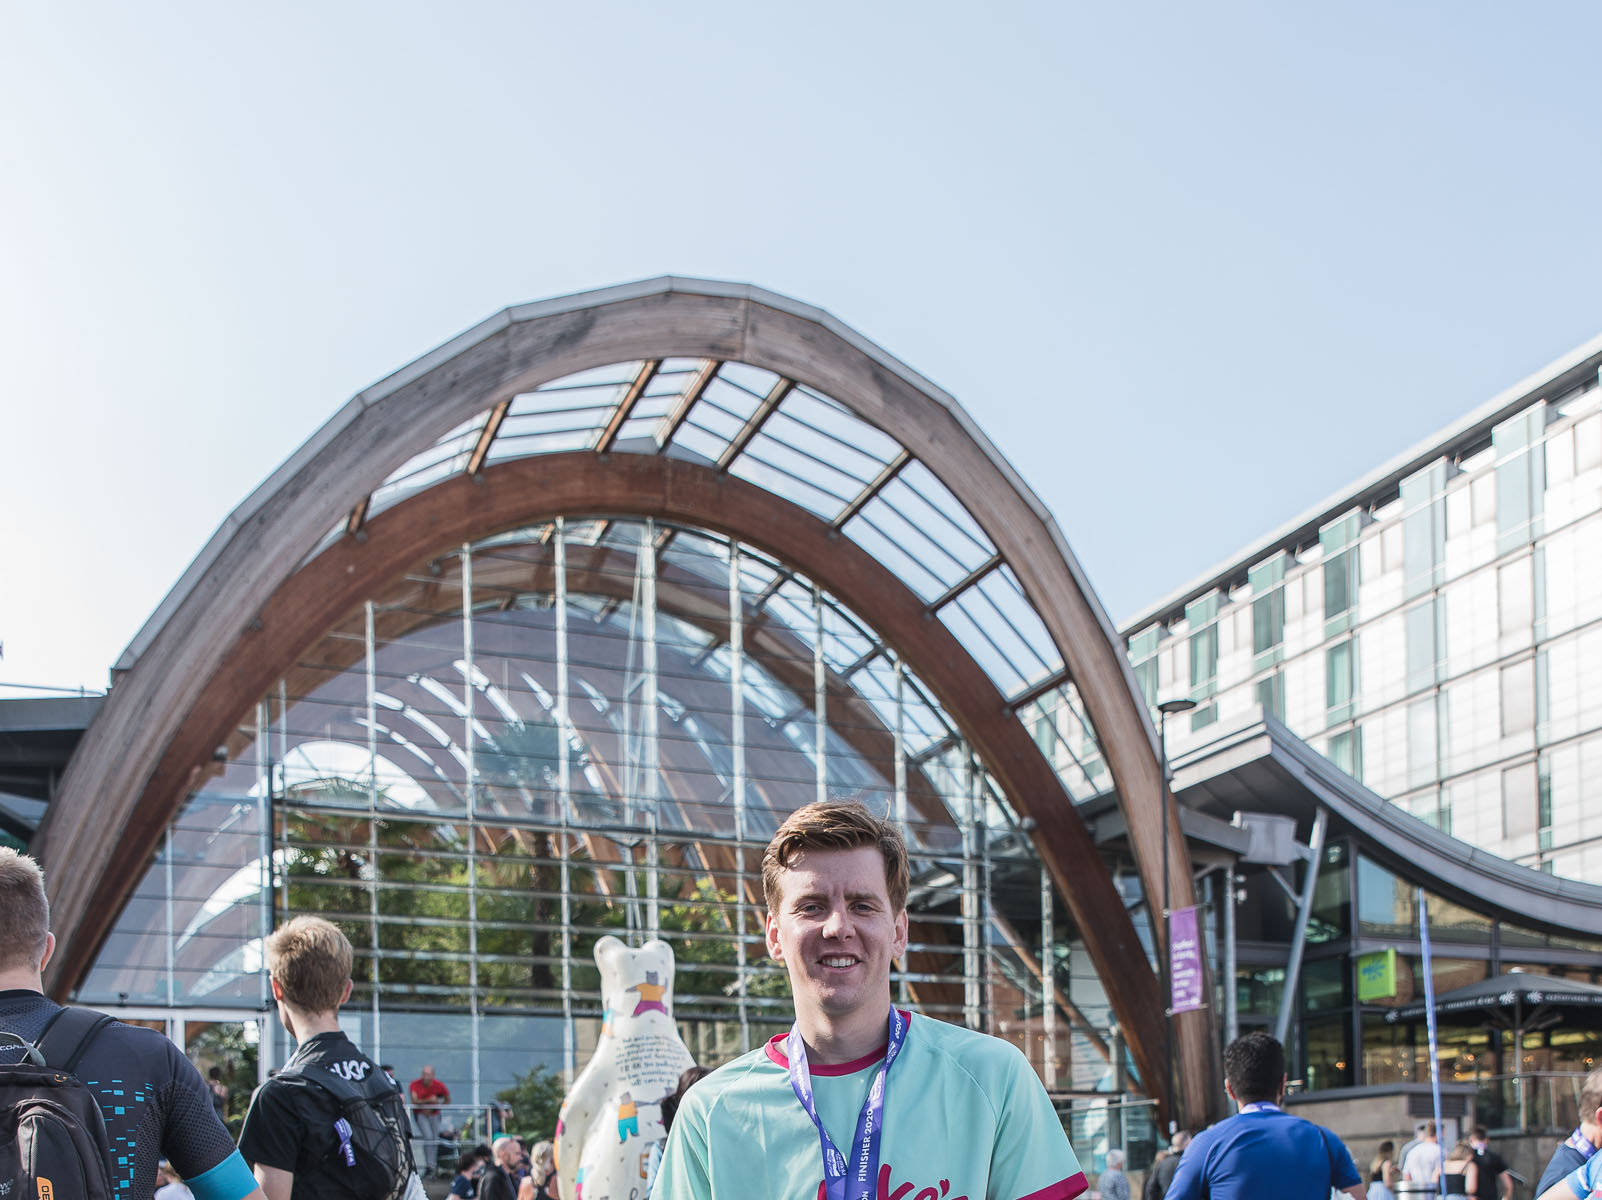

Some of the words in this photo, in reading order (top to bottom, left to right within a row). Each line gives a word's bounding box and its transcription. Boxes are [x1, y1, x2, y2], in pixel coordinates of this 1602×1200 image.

[864, 1108, 874, 1134] 2020
[858, 1136, 871, 1182] FINISHER
[41, 1185, 51, 1200] 30
